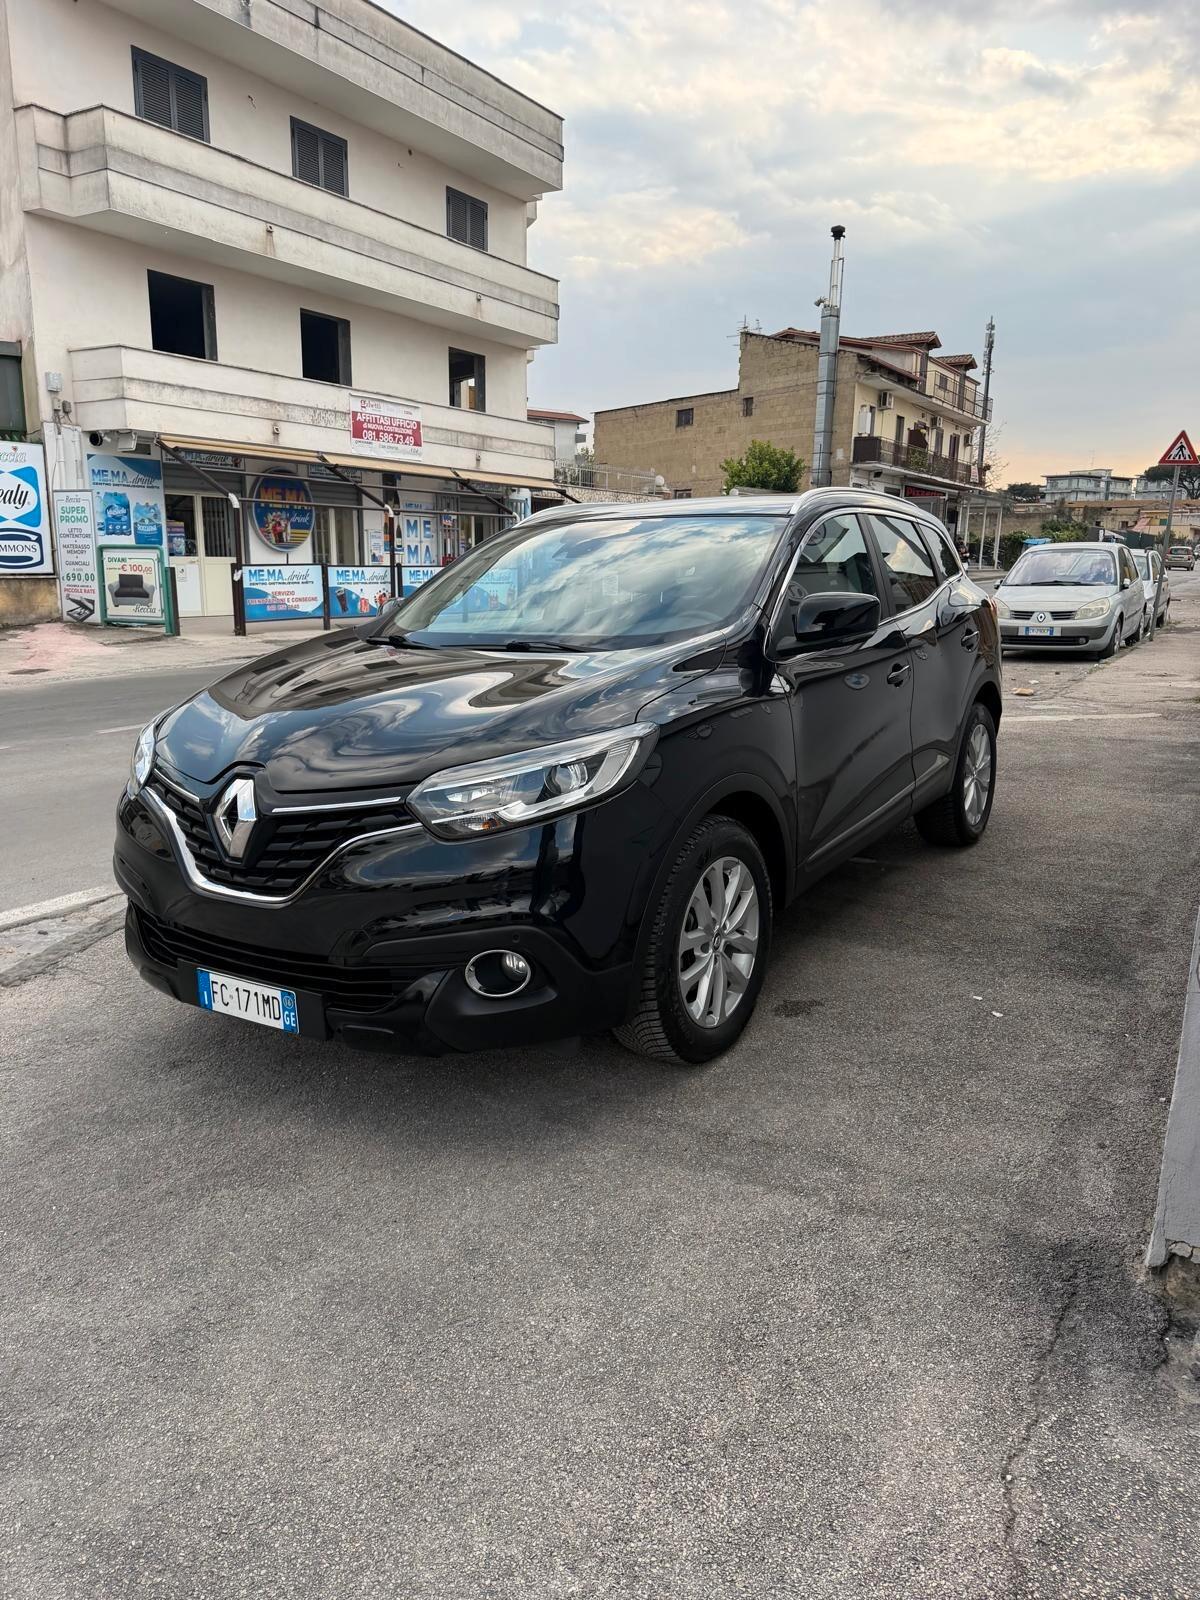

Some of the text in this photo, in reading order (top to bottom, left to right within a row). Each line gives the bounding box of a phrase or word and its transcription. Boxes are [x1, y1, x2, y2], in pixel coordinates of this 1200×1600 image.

[356, 412, 417, 430] AFFITTASI UFFICIO
[384, 426, 413, 434] COSTRUZIONE
[0, 484, 28, 509] ealy
[60, 506, 86, 514] SUPER
[290, 512, 310, 523] drink
[288, 569, 310, 580] drink
[369, 570, 388, 581] drink
[135, 604, 156, 613] Reccia
[284, 1011, 296, 1027] GE
